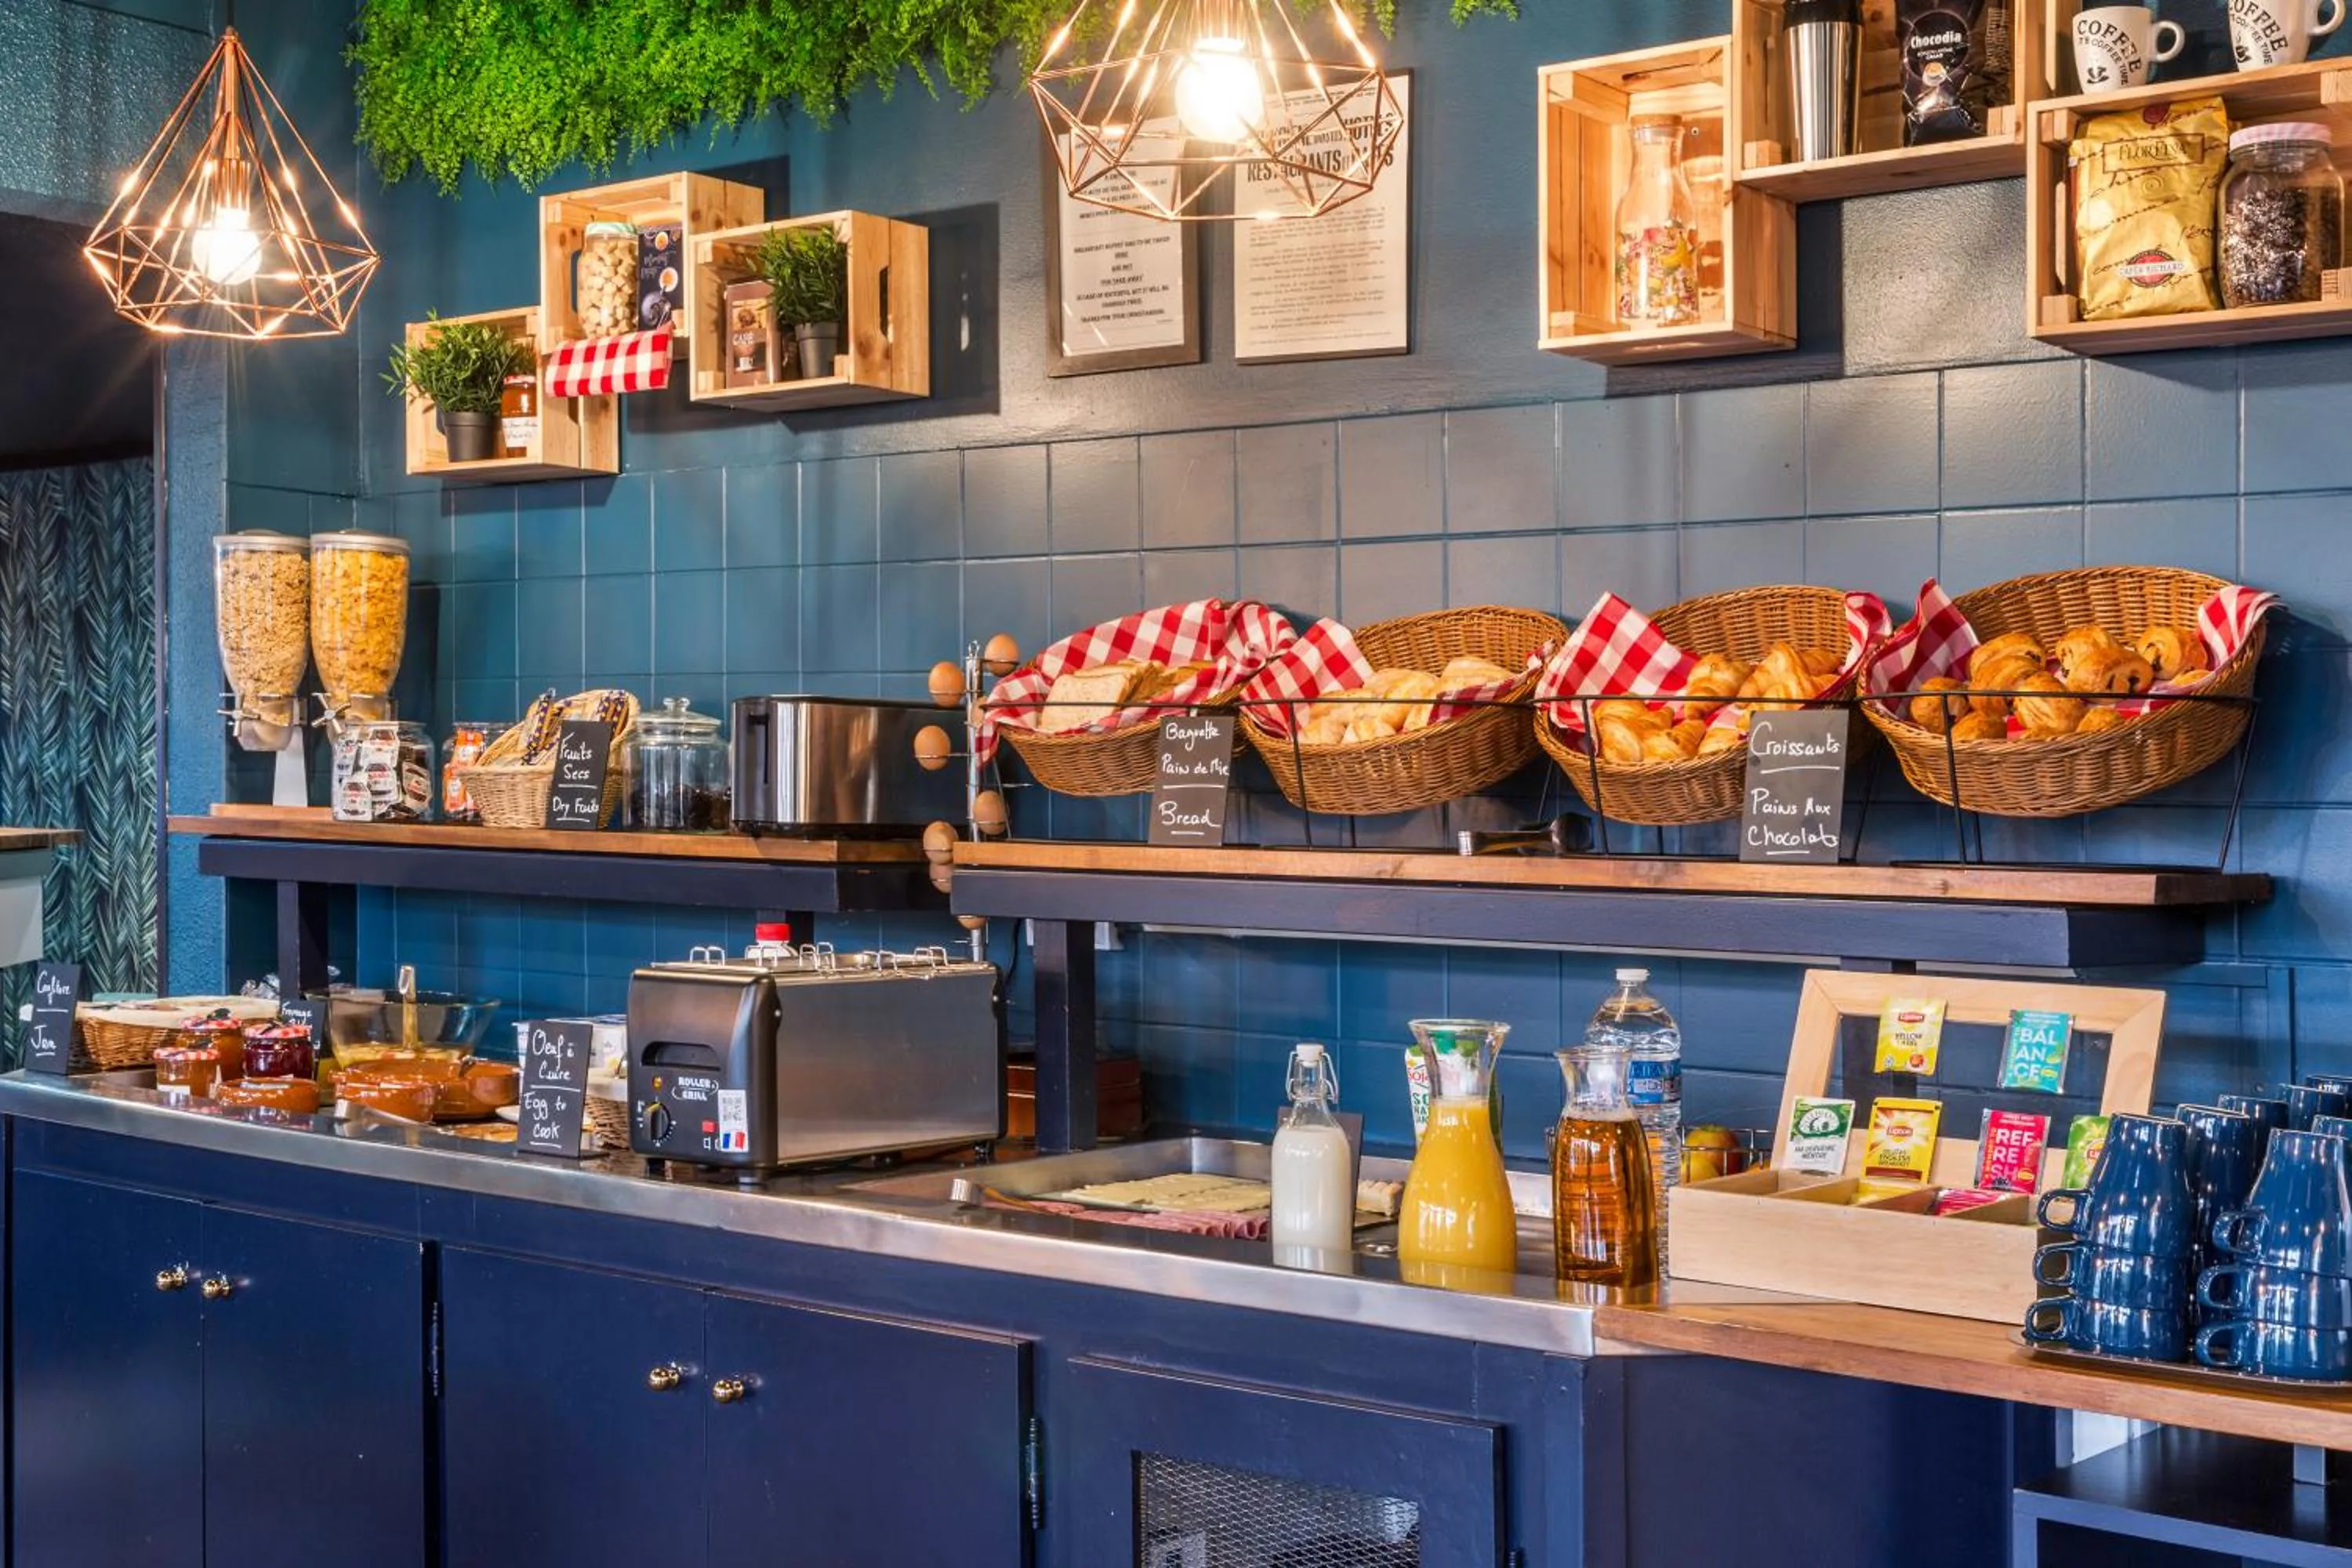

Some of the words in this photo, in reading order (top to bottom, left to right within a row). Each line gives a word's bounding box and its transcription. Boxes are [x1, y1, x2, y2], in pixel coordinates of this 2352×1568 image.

[2230, 0, 2288, 51] OFFEE
[1911, 31, 1962, 49] Chocodia
[2078, 20, 2142, 74] COFFEE
[2092, 38, 2122, 65] COFFEE
[2119, 63, 2129, 85] TIME
[1247, 150, 1341, 182] RESAURANTS
[1166, 720, 1221, 751] Baguette
[1750, 721, 1841, 756] Croissants
[564, 763, 590, 779] Secs
[1162, 753, 1189, 775] Pain
[1194, 762, 1207, 774] de
[1210, 758, 1230, 776] Mie
[553, 796, 570, 818] Dry
[1751, 788, 1797, 815] Pains
[1804, 797, 1831, 815] Aux
[1159, 800, 1221, 827] Bread
[2020, 1028, 2057, 1044] BAL
[2016, 1046, 2047, 1062] AN
[539, 1060, 571, 1080] Cuire
[2013, 1063, 2042, 1078] CE
[678, 1076, 711, 1088] ROLLER
[524, 1091, 548, 1120] Egg
[555, 1095, 567, 1111] to
[681, 1091, 707, 1102] GRILL
[1996, 1129, 2034, 1146] REF
[1993, 1146, 2020, 1163] RE
[1991, 1164, 2018, 1181] SH
